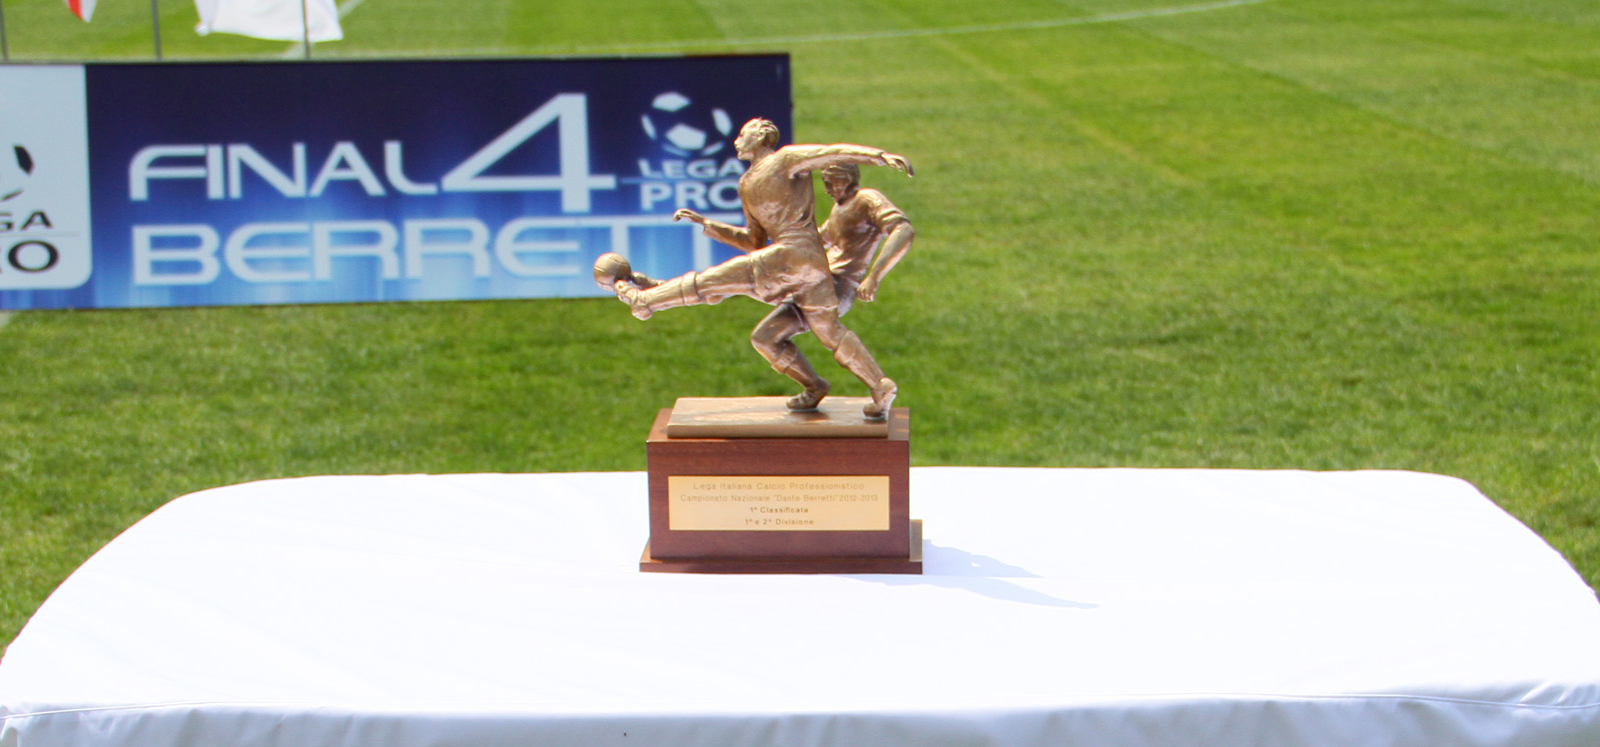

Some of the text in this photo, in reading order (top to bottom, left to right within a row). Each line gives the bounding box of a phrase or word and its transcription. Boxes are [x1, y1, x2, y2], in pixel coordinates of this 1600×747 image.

[638, 157, 745, 179] LEGA
[640, 179, 742, 210] PRO
[0, 239, 59, 274] O
[133, 212, 745, 287] BERRETT
[680, 494, 728, 503] Campionato
[731, 494, 770, 502] Nazionale
[693, 482, 865, 491] Lega Italiana Calcio Professionistico
